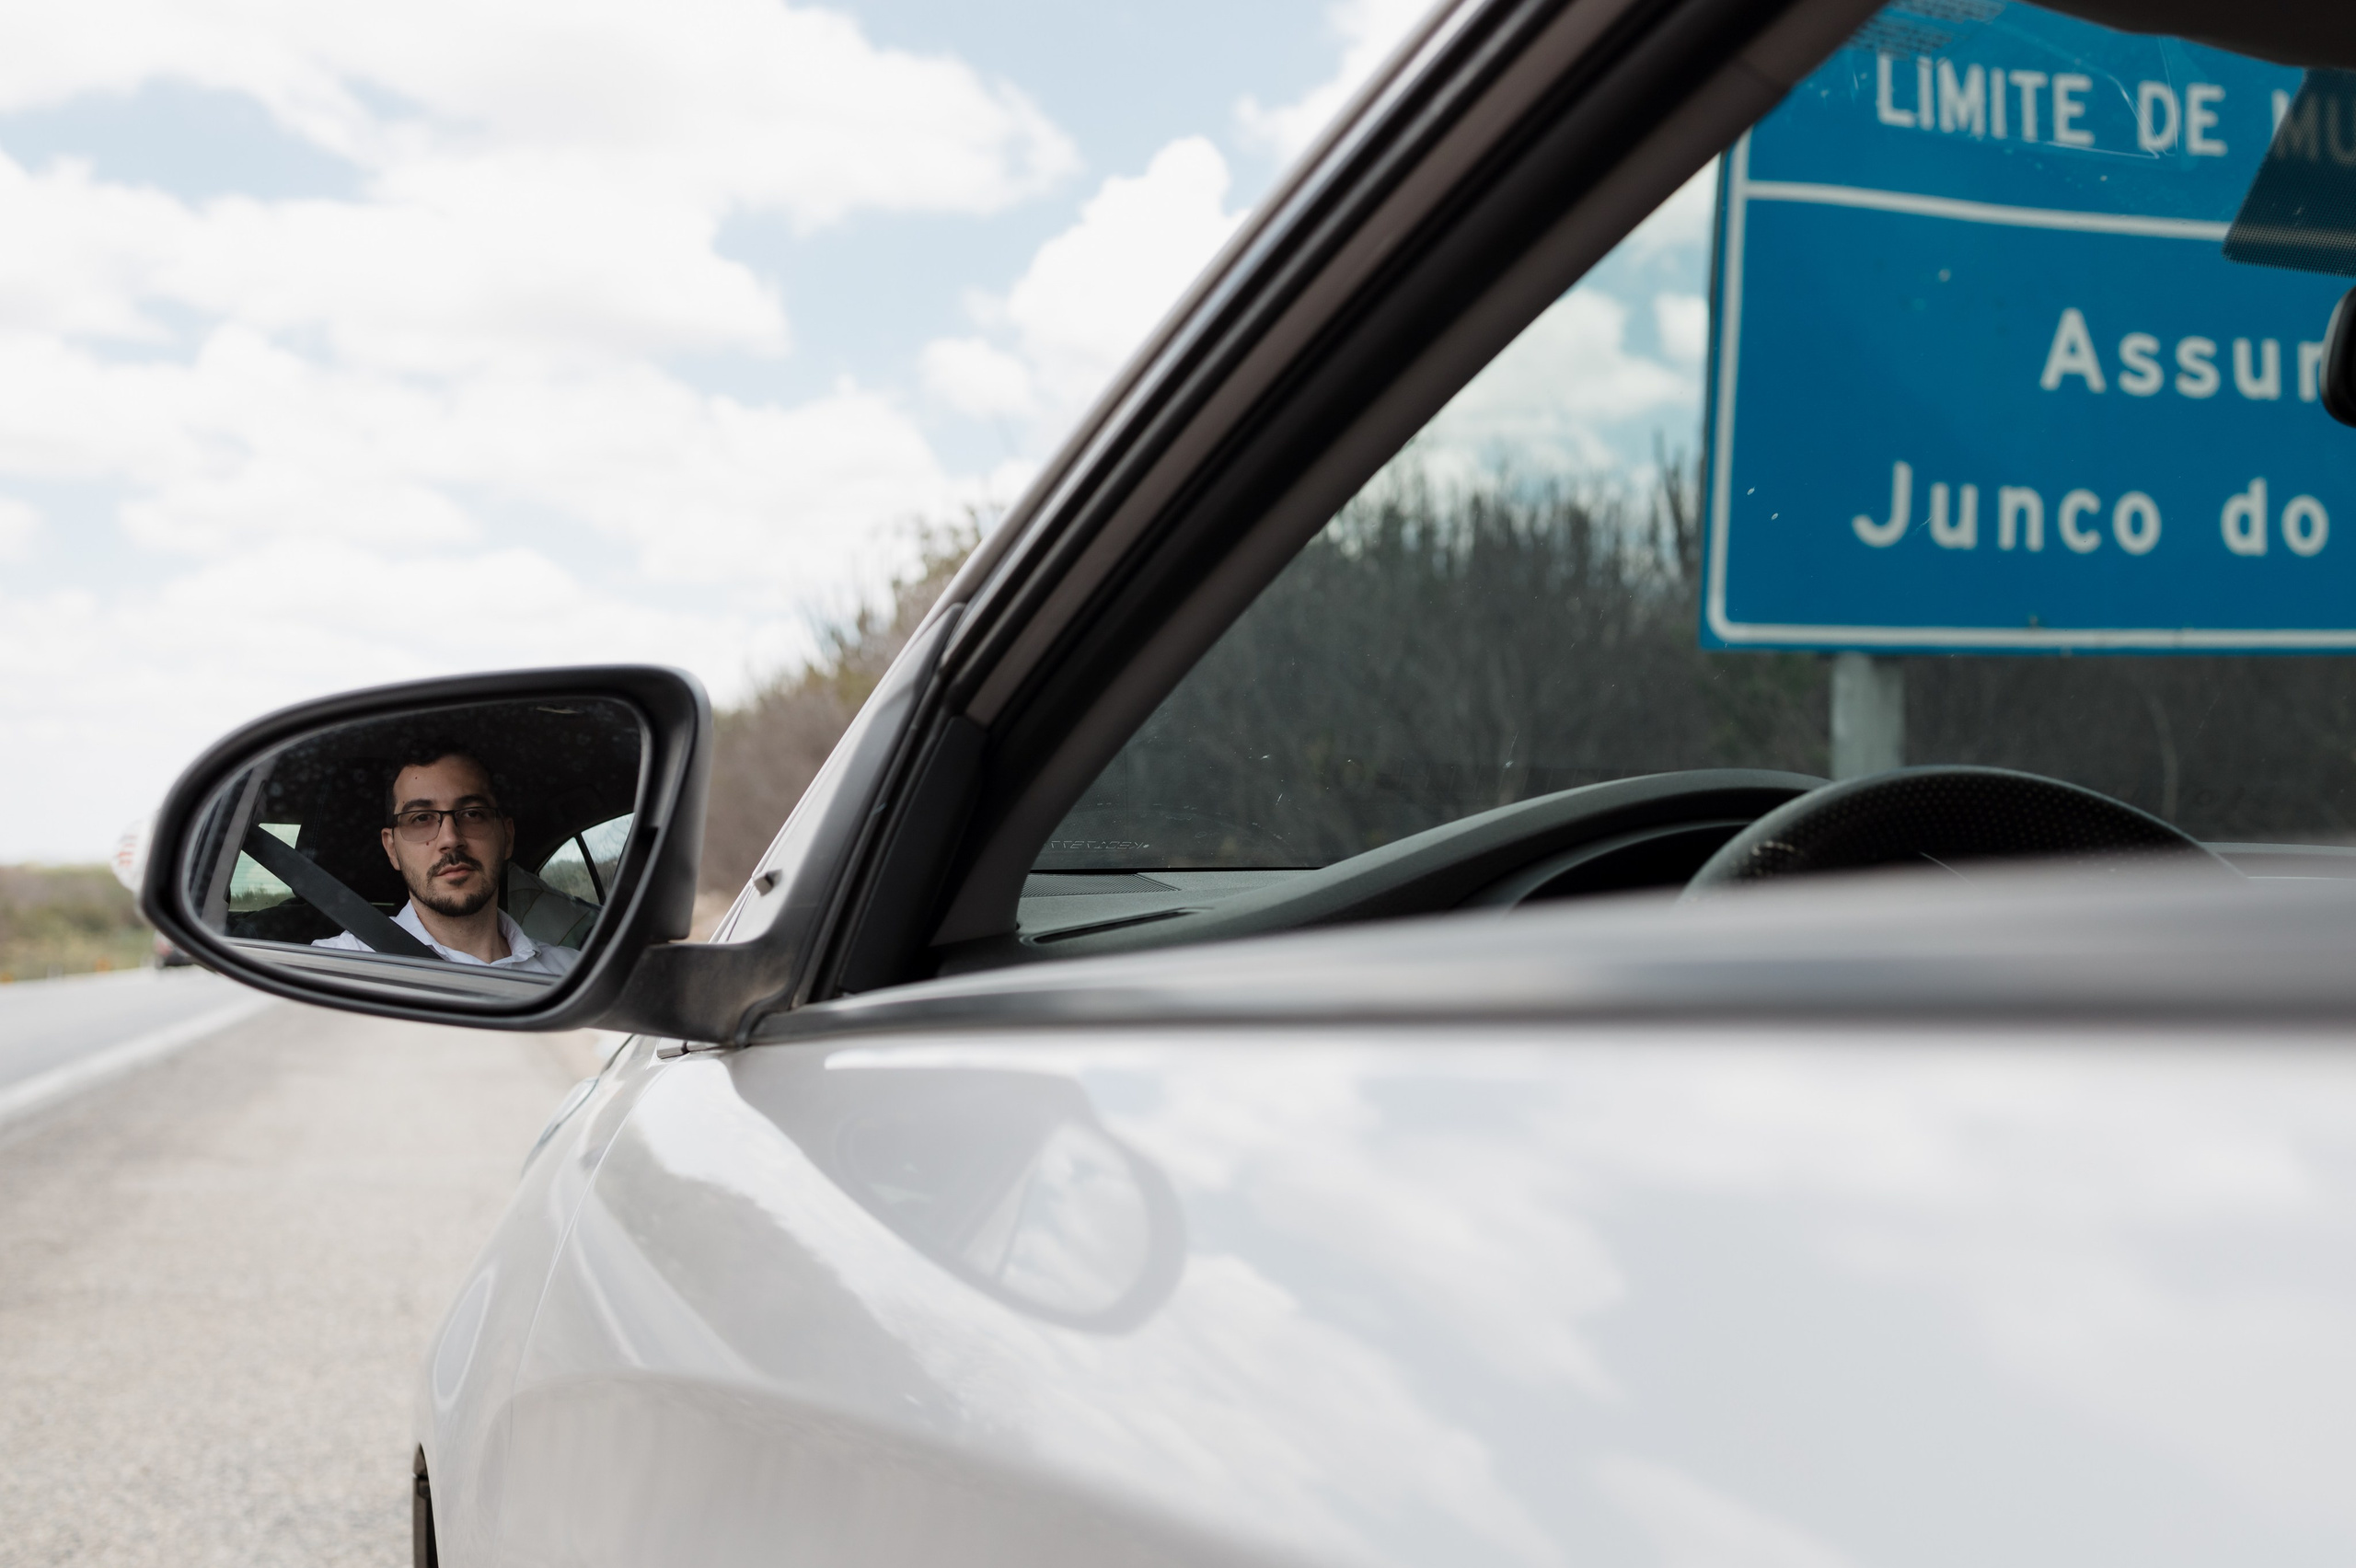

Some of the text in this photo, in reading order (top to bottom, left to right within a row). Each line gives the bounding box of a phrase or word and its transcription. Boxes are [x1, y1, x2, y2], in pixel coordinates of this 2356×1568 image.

[1876, 52, 2095, 149] LIMITE
[2136, 81, 2227, 158] DE
[1853, 461, 2329, 556] Junco do
